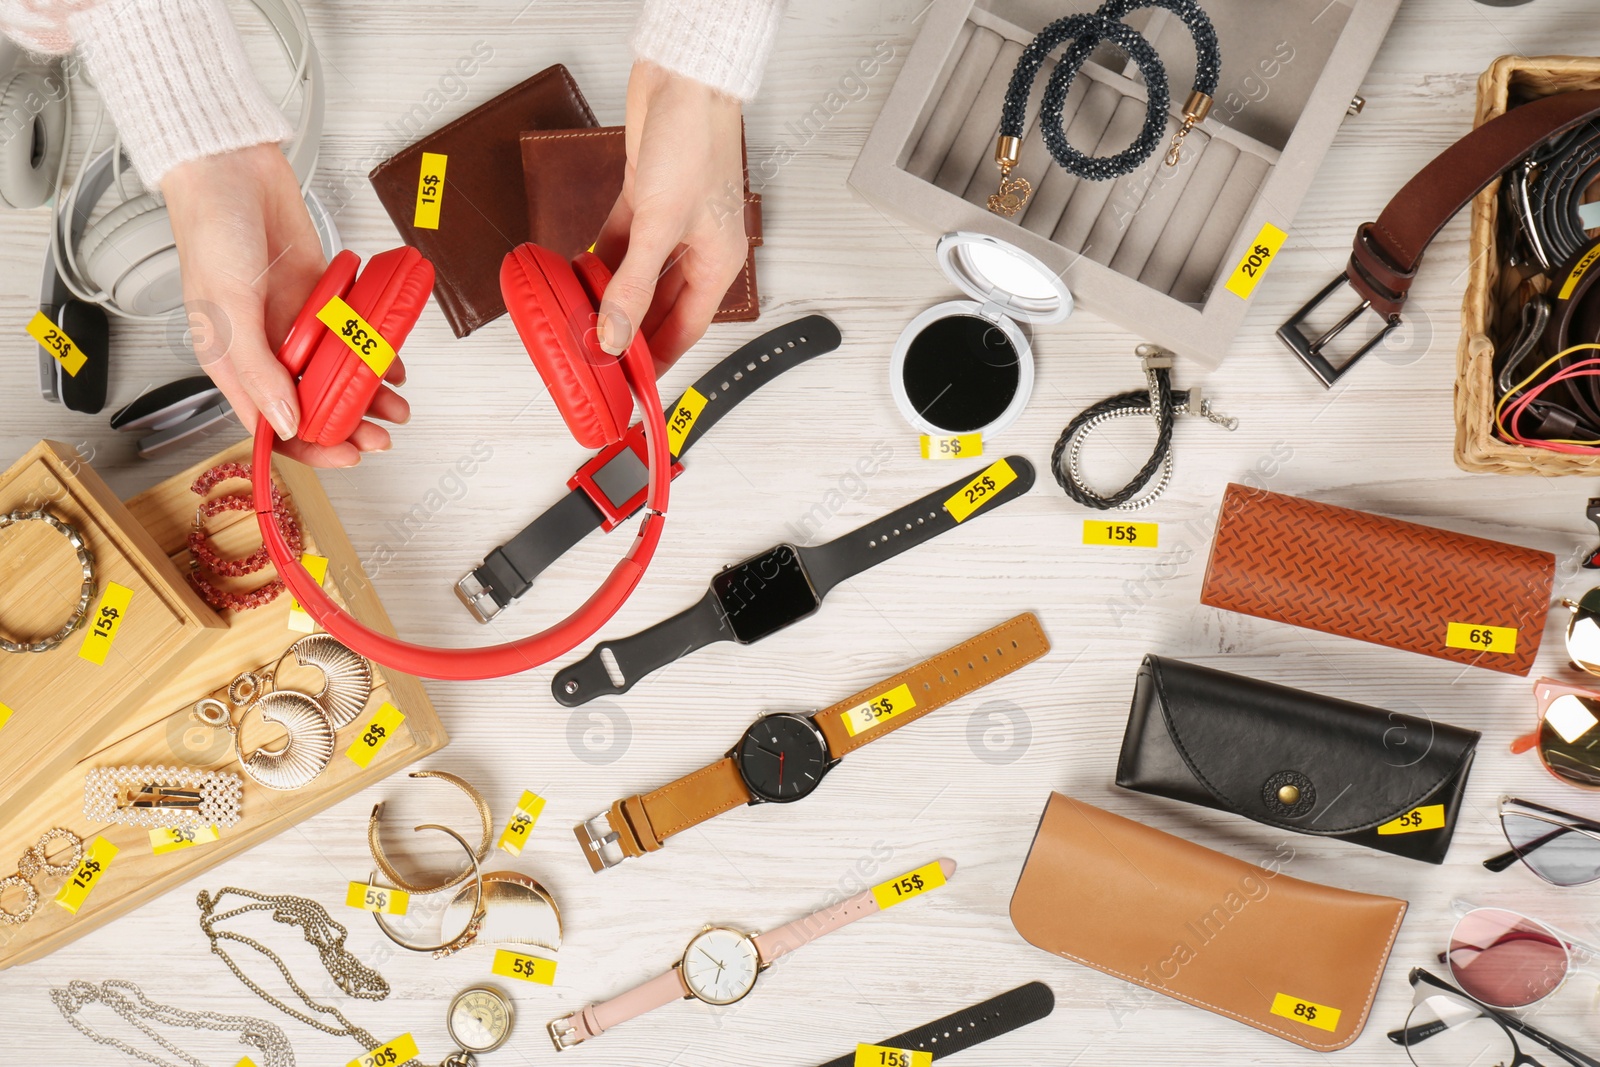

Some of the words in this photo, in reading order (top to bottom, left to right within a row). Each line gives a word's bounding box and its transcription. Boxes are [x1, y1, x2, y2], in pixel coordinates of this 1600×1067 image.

[422, 175, 440, 205] 15$
[1242, 245, 1270, 278] 20$
[44, 330, 71, 358] 25$
[342, 319, 377, 355] 33$
[672, 407, 692, 434] 15$
[940, 439, 962, 455] 5$
[965, 476, 995, 504] 25$
[1106, 526, 1137, 543] 15$
[94, 606, 119, 638] 15$
[1470, 630, 1493, 647] 6$
[861, 698, 893, 722] 35$
[363, 724, 386, 747] 8$
[511, 813, 532, 834] 5$
[1400, 811, 1423, 827] 5$
[172, 826, 196, 843] 3$
[73, 859, 101, 889] 15$
[892, 874, 924, 896] 15$
[365, 891, 387, 909] 5$
[513, 958, 534, 978] 5$
[1294, 1003, 1317, 1021] 8$
[365, 1047, 397, 1067] 20$
[879, 1051, 910, 1067] 15$
